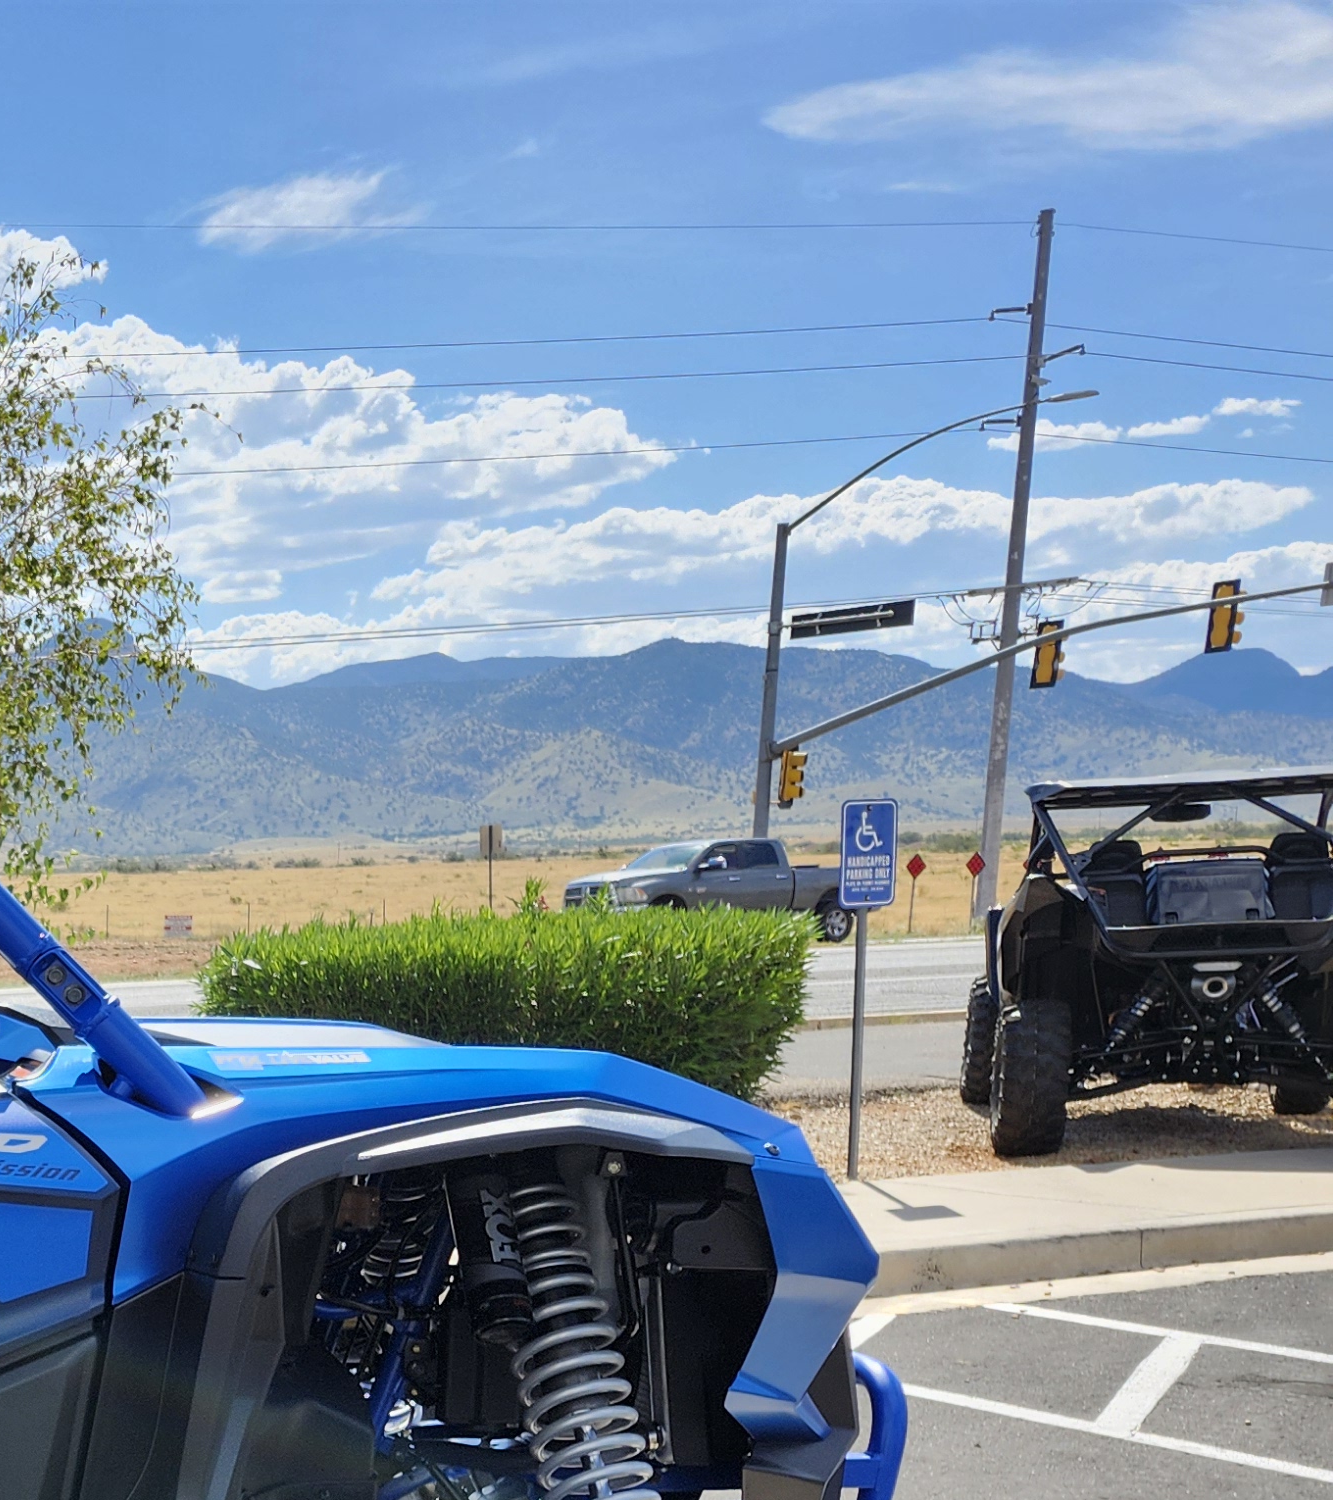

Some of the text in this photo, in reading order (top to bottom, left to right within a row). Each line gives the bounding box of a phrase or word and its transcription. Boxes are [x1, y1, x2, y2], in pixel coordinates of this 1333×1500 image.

[847, 855, 890, 868] HANDICAPPED
[846, 867, 890, 880] PARKING ONLY
[480, 1188, 523, 1264] FOX
